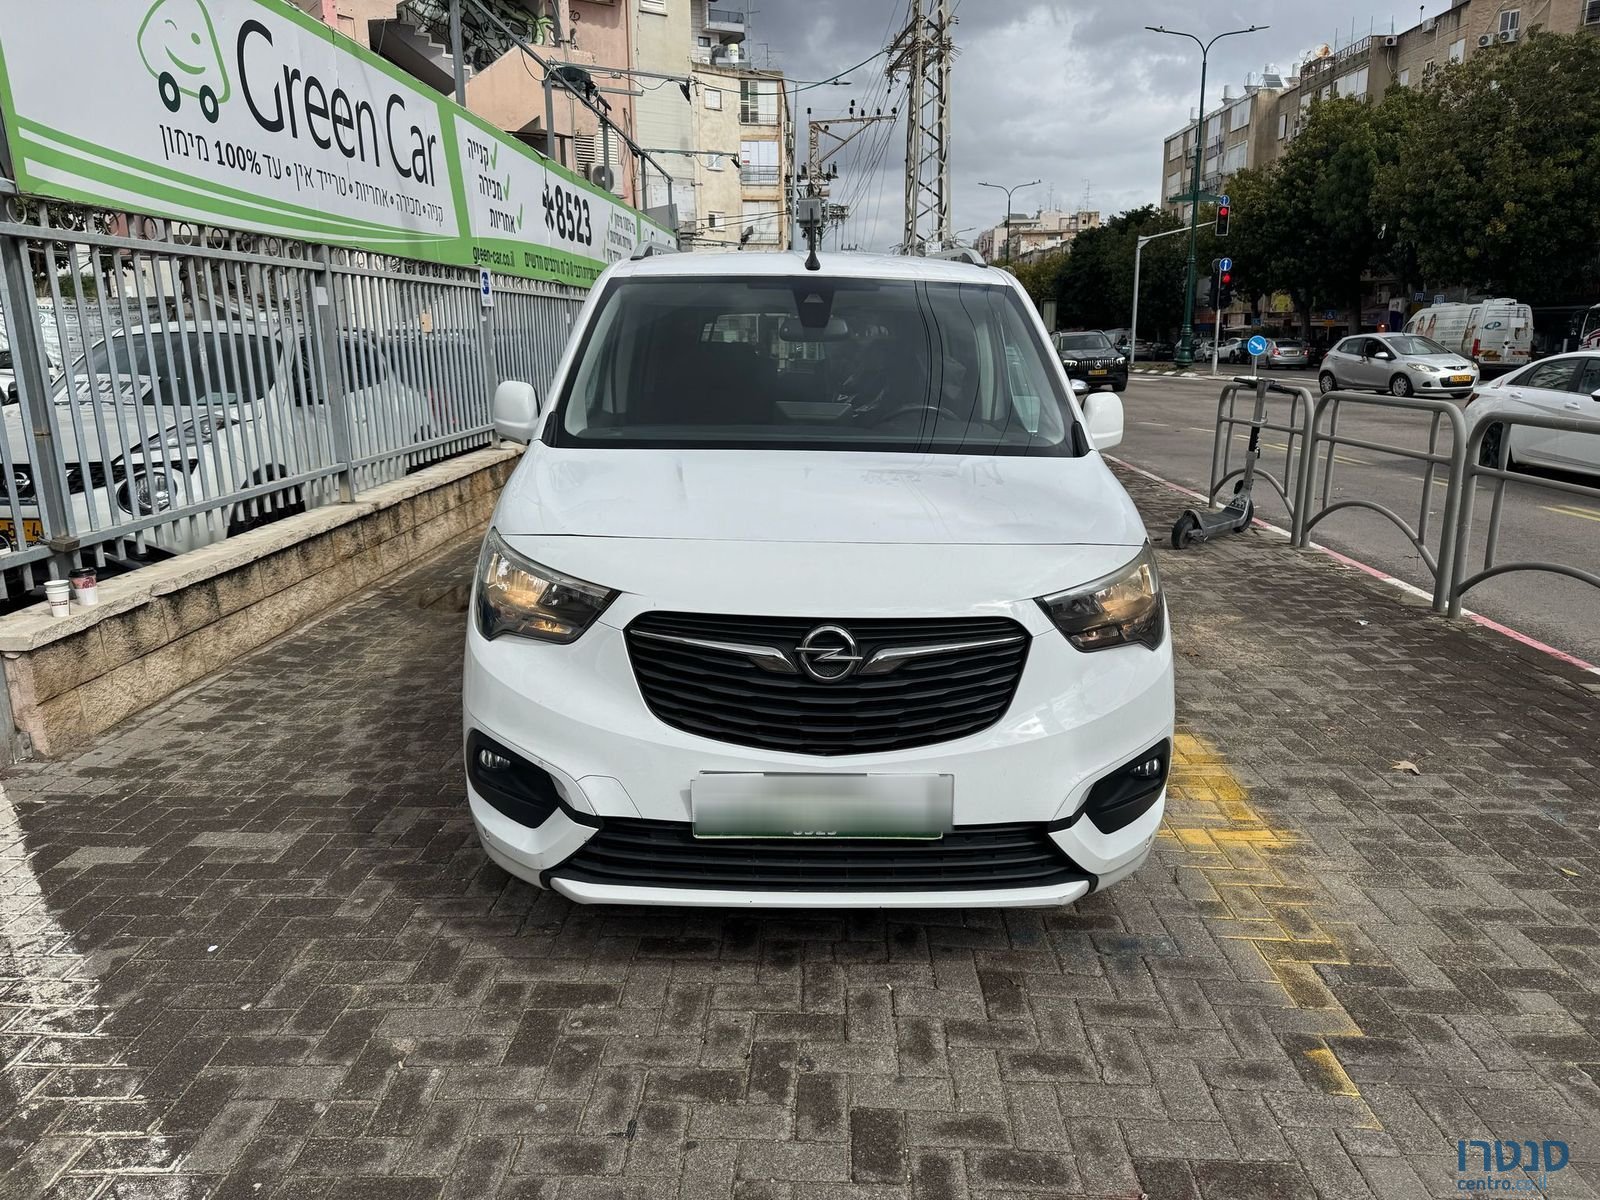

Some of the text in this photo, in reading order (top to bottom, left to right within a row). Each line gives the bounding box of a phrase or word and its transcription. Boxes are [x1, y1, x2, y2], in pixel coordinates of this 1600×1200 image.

[237, 19, 436, 187] Green Car
[159, 124, 209, 161] מימון
[214, 140, 262, 174] 100%
[262, 154, 282, 180] עד
[294, 162, 315, 191] אין
[478, 174, 503, 201] מכירה
[489, 208, 516, 234] אחריות
